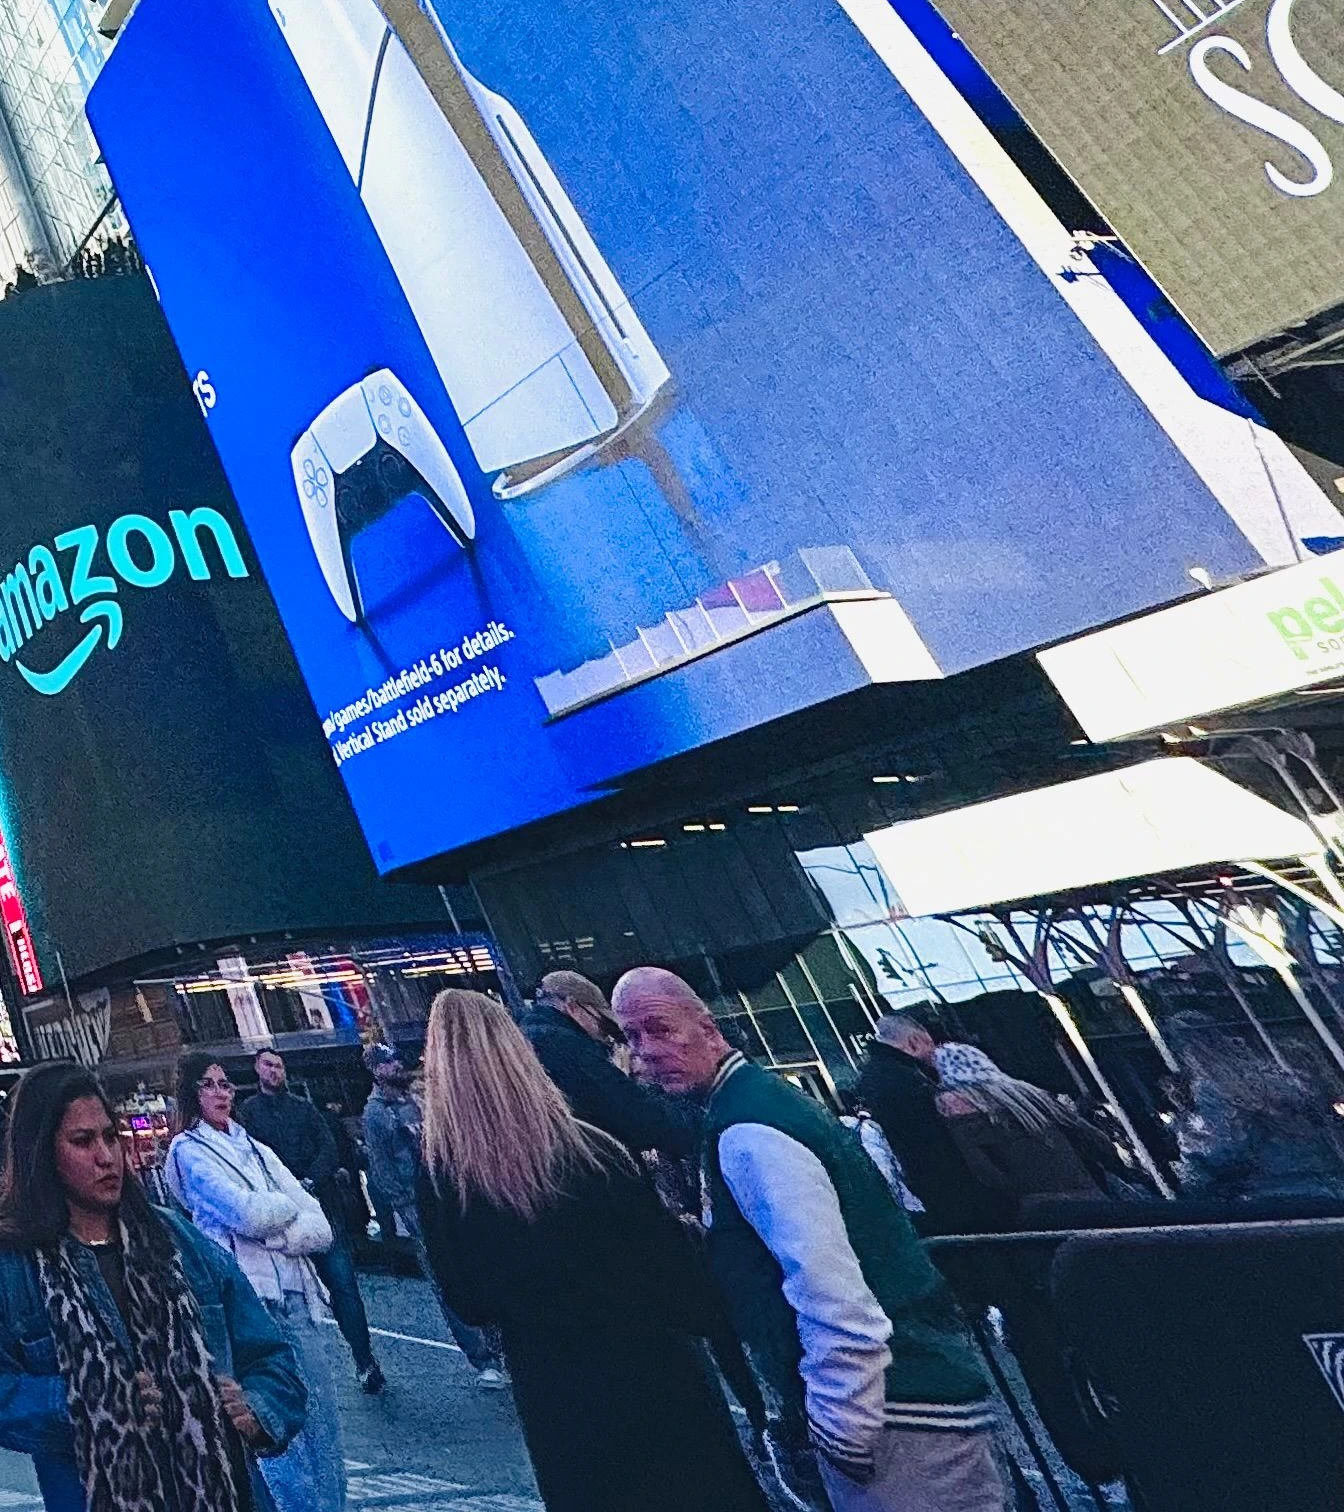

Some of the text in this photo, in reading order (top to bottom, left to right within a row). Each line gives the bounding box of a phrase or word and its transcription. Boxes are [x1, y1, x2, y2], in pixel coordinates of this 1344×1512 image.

[439, 646, 462, 671] for
[461, 620, 516, 660] details.
[335, 664, 507, 761] Vertical Stand sold separately.
